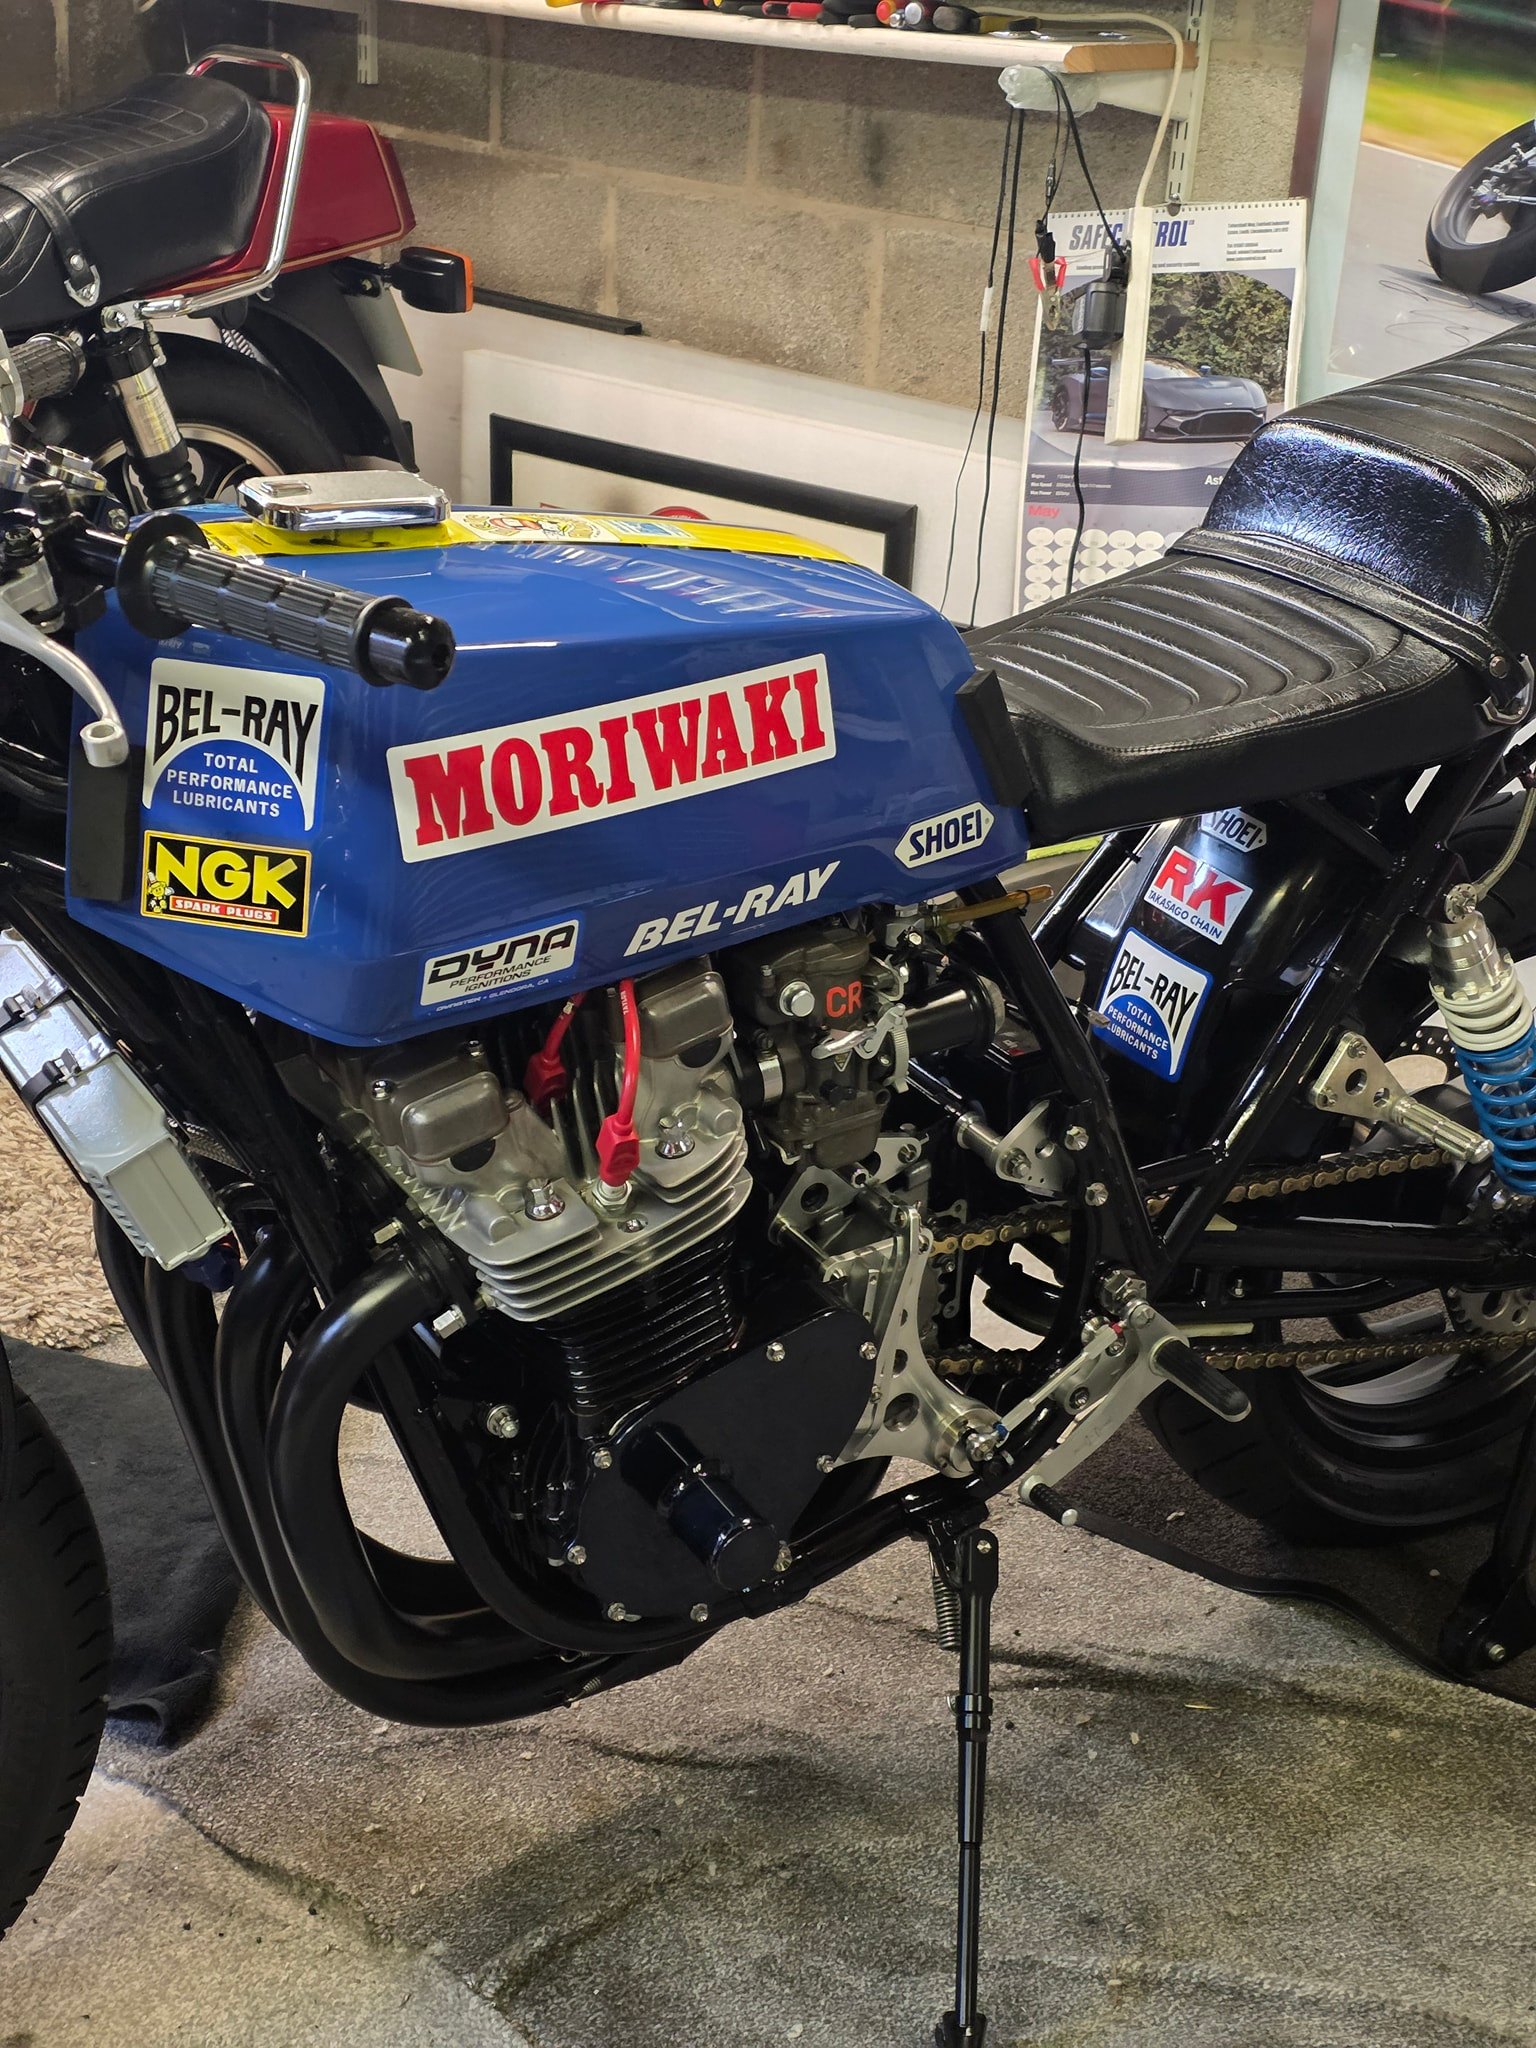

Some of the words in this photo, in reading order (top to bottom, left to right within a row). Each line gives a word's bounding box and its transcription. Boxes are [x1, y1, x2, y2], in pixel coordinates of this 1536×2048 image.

[1028, 504, 1060, 519] May
[153, 684, 318, 787] BEL-RAY
[203, 752, 259, 774] TOTAL
[403, 668, 827, 846] MORIWAKI
[166, 768, 293, 800] PERFORMANCE
[173, 789, 280, 818] LUBRICANTS
[908, 808, 984, 862] SHOEI
[156, 841, 298, 910] NGK
[1153, 850, 1246, 928] RK
[174, 898, 221, 916] SPARK
[226, 906, 273, 922] PLUGS
[623, 860, 840, 957] BEL-RAY
[1148, 890, 1189, 920] TAKASAGO
[1190, 915, 1223, 939] CHAIN
[427, 924, 576, 985] DYNA
[450, 955, 552, 989] PERFORMANCE
[465, 969, 532, 993] IGNITIONS
[536, 978, 549, 986] CA
[826, 980, 862, 1018] CR
[1107, 949, 1198, 1044] BEL-RAY
[1107, 1005, 1169, 1051] PERFORMANCE
[1126, 1001, 1152, 1026] TOTAL
